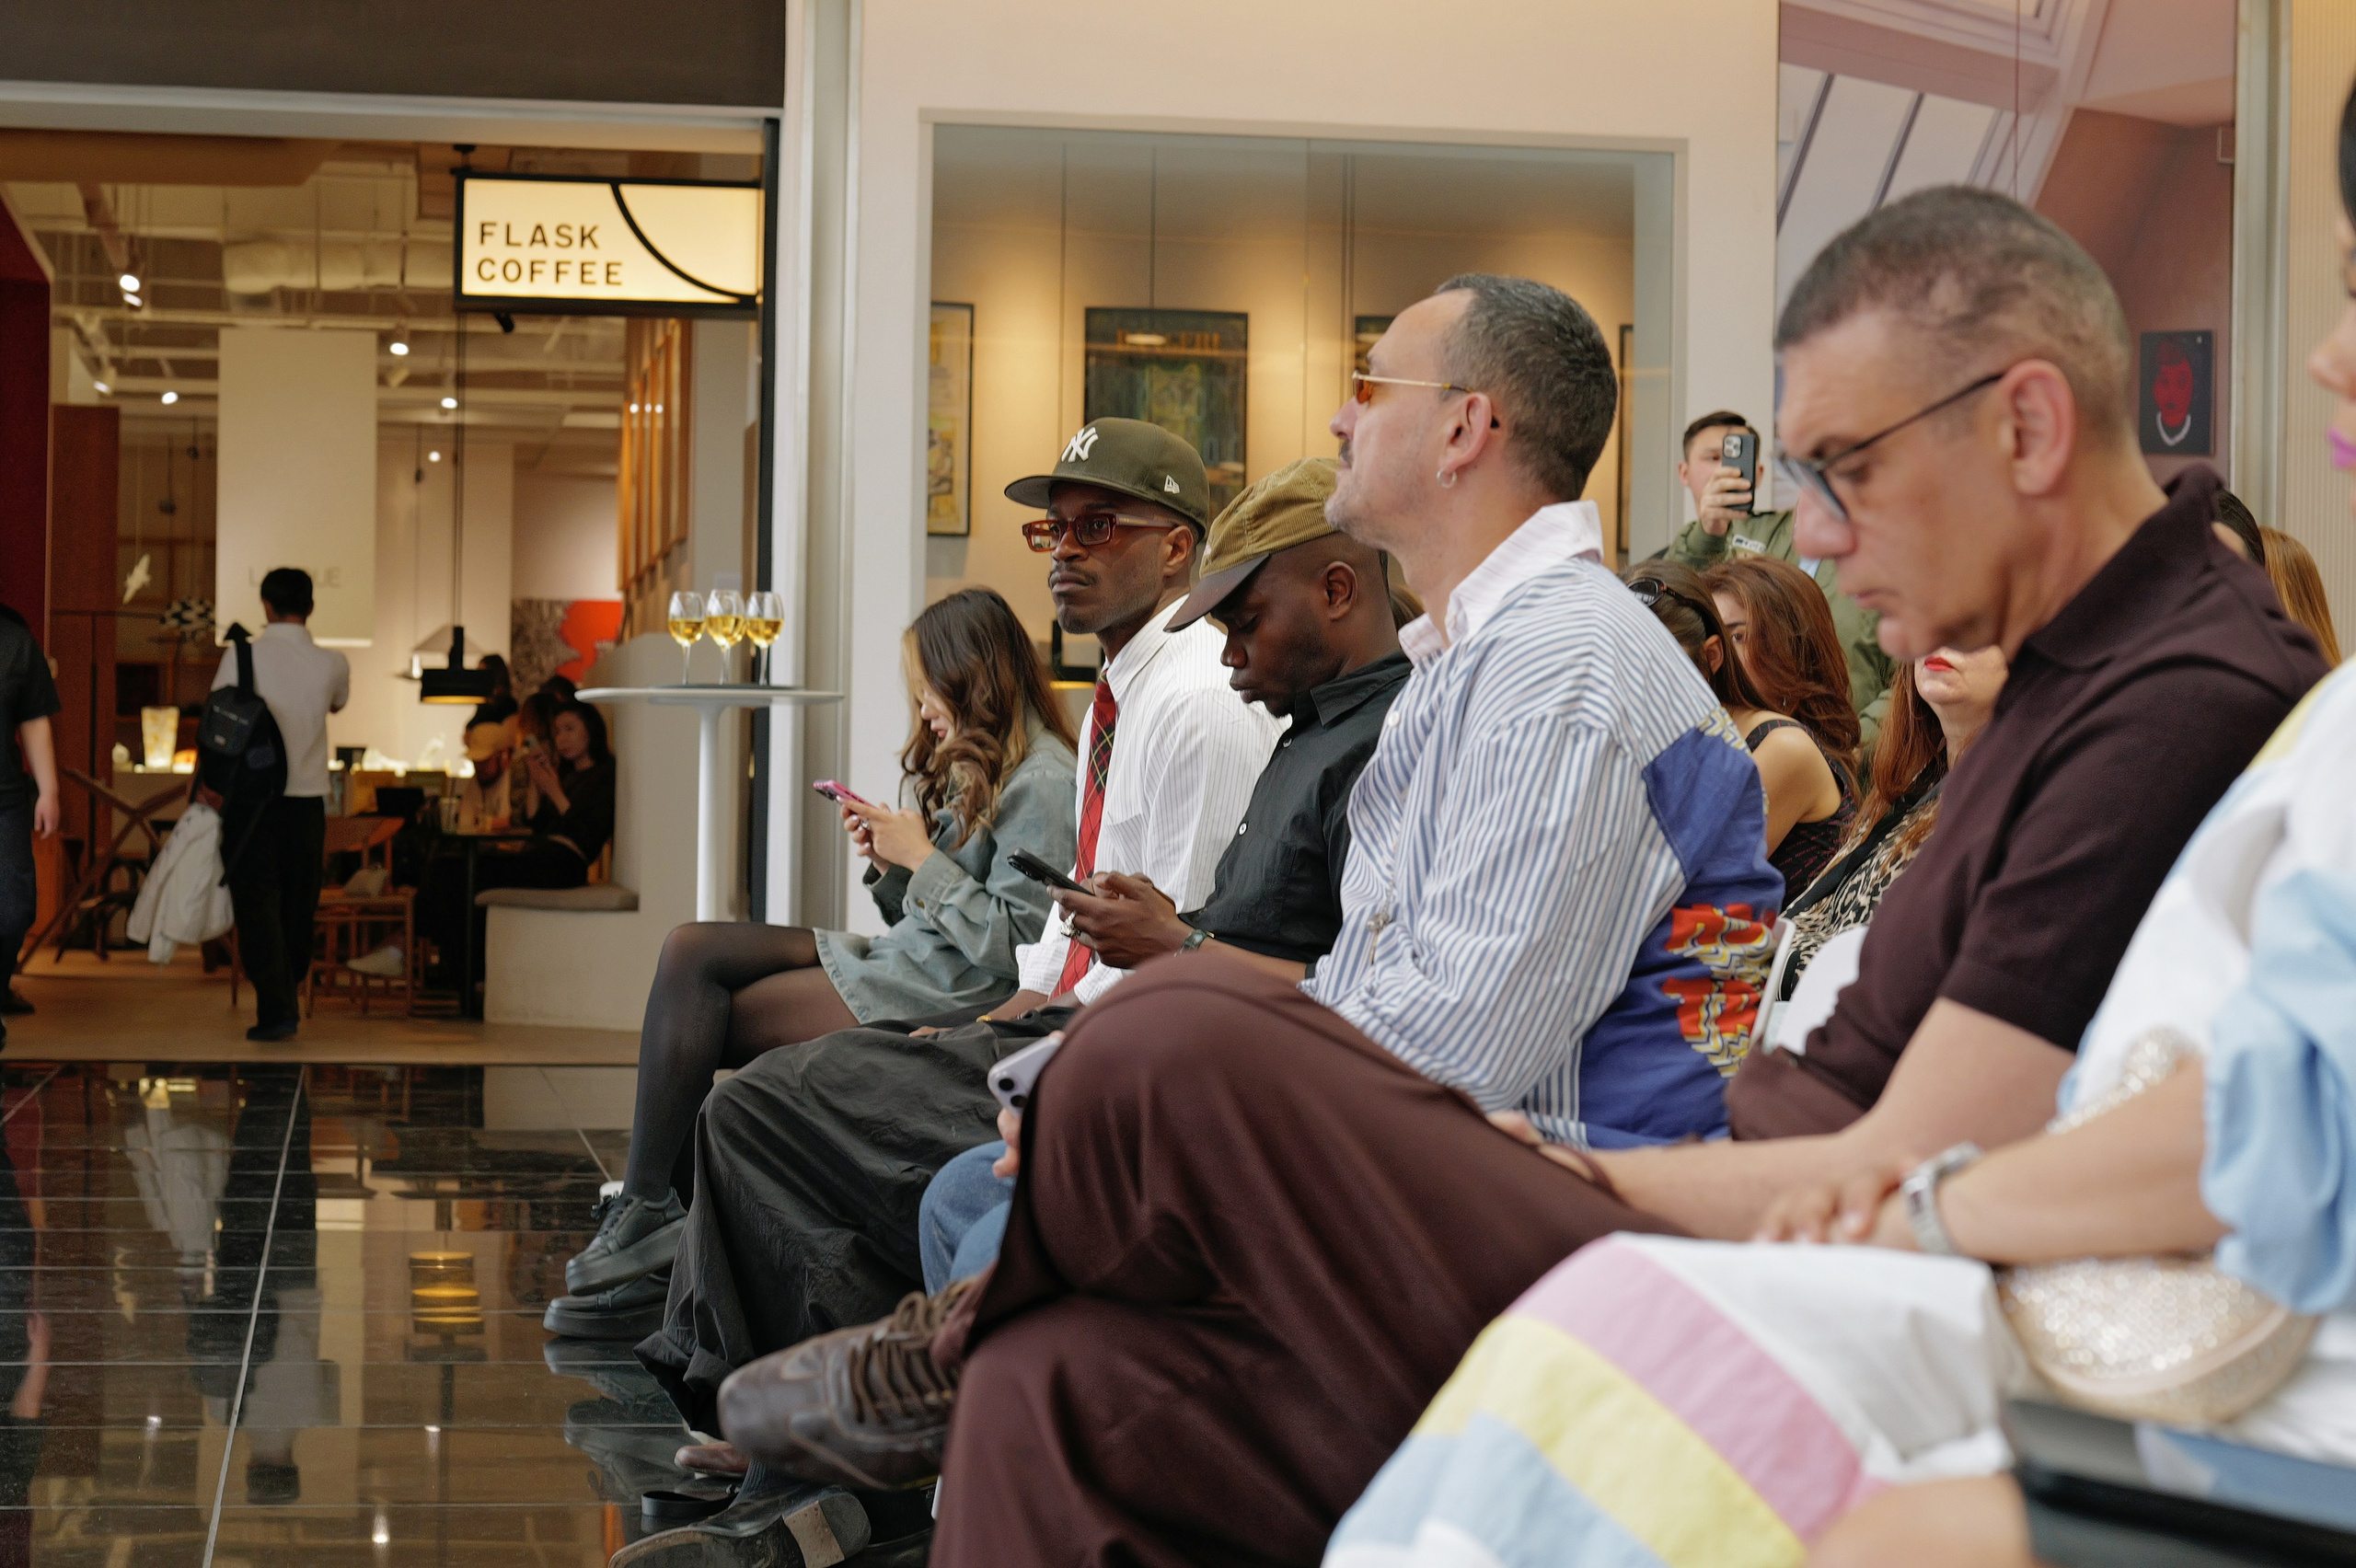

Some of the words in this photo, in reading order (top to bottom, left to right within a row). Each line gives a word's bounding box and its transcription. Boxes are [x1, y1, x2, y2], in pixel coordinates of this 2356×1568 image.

[479, 222, 599, 249] FLASK
[477, 258, 623, 286] COFFEE
[1061, 426, 1099, 463] NY
